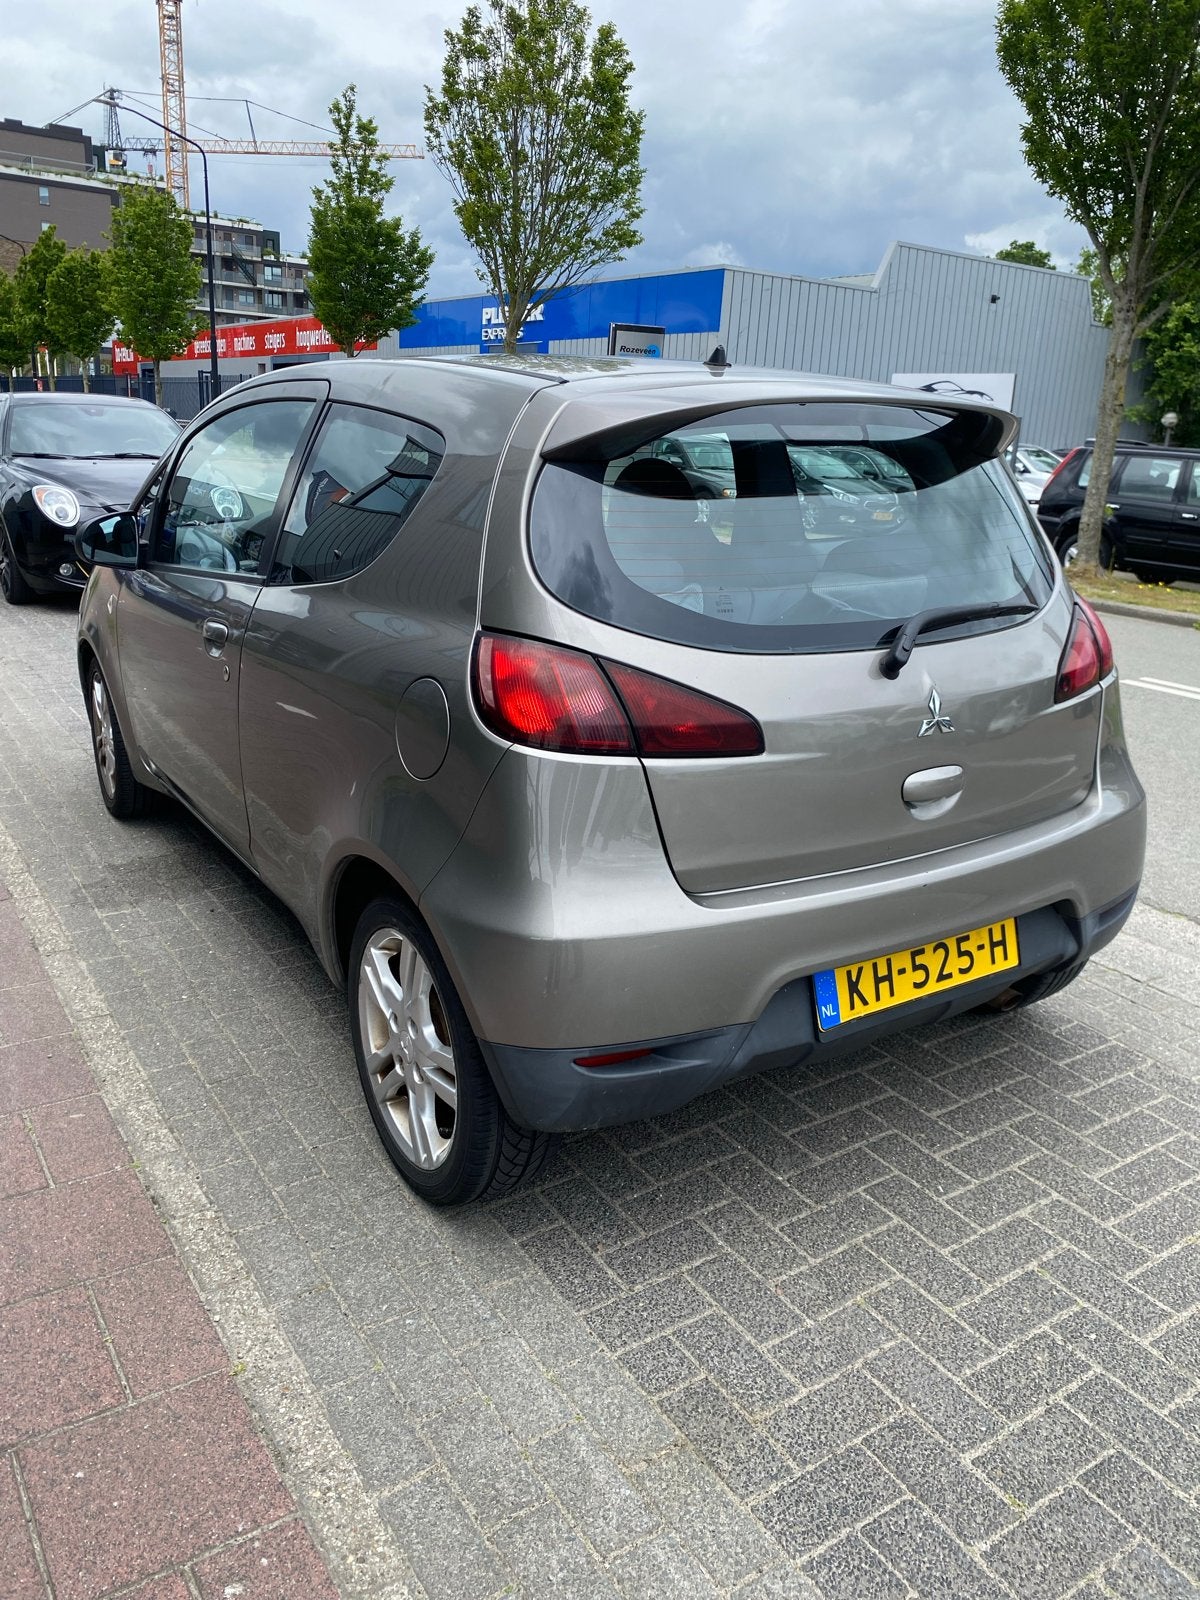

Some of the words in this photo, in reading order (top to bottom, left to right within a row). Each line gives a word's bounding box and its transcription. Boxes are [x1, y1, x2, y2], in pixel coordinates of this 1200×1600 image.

[482, 303, 544, 325] PLIER
[233, 332, 256, 351] machines
[264, 329, 286, 353] steigers
[295, 324, 334, 351] hoogwerker
[481, 327, 524, 341] EXPRS
[619, 345, 656, 355] Rozeveen
[846, 924, 1008, 1011] KH-525-H
[821, 1003, 837, 1019] NL
